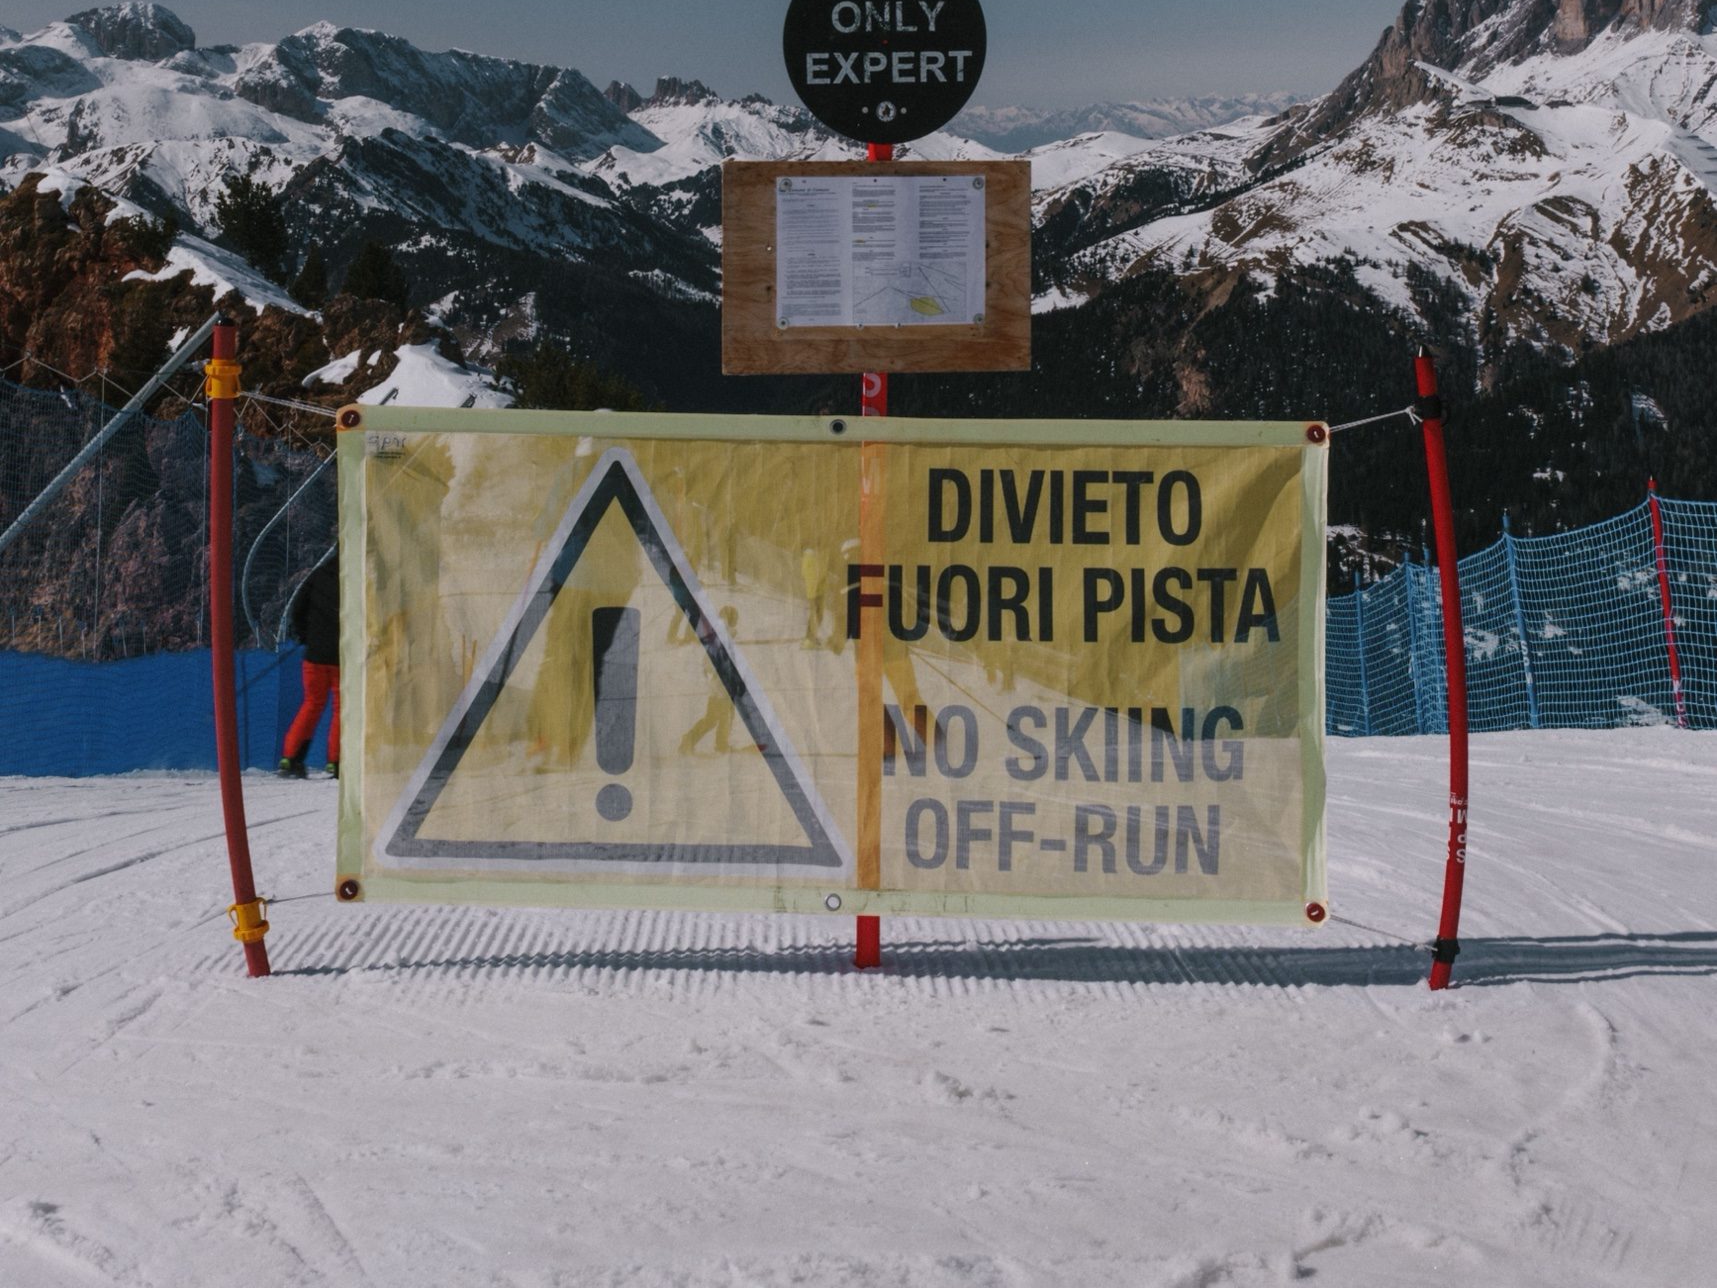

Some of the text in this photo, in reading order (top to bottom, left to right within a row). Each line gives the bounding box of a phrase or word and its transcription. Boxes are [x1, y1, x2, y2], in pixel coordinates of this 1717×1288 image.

[831, 0, 944, 33] ONLY
[806, 50, 973, 85] EXPERT
[928, 468, 1202, 546] DIVIETO
[846, 563, 1280, 644] FUORI PISTA
[882, 703, 1245, 783] NO SKIING
[904, 797, 1220, 876] OFF-RUN
